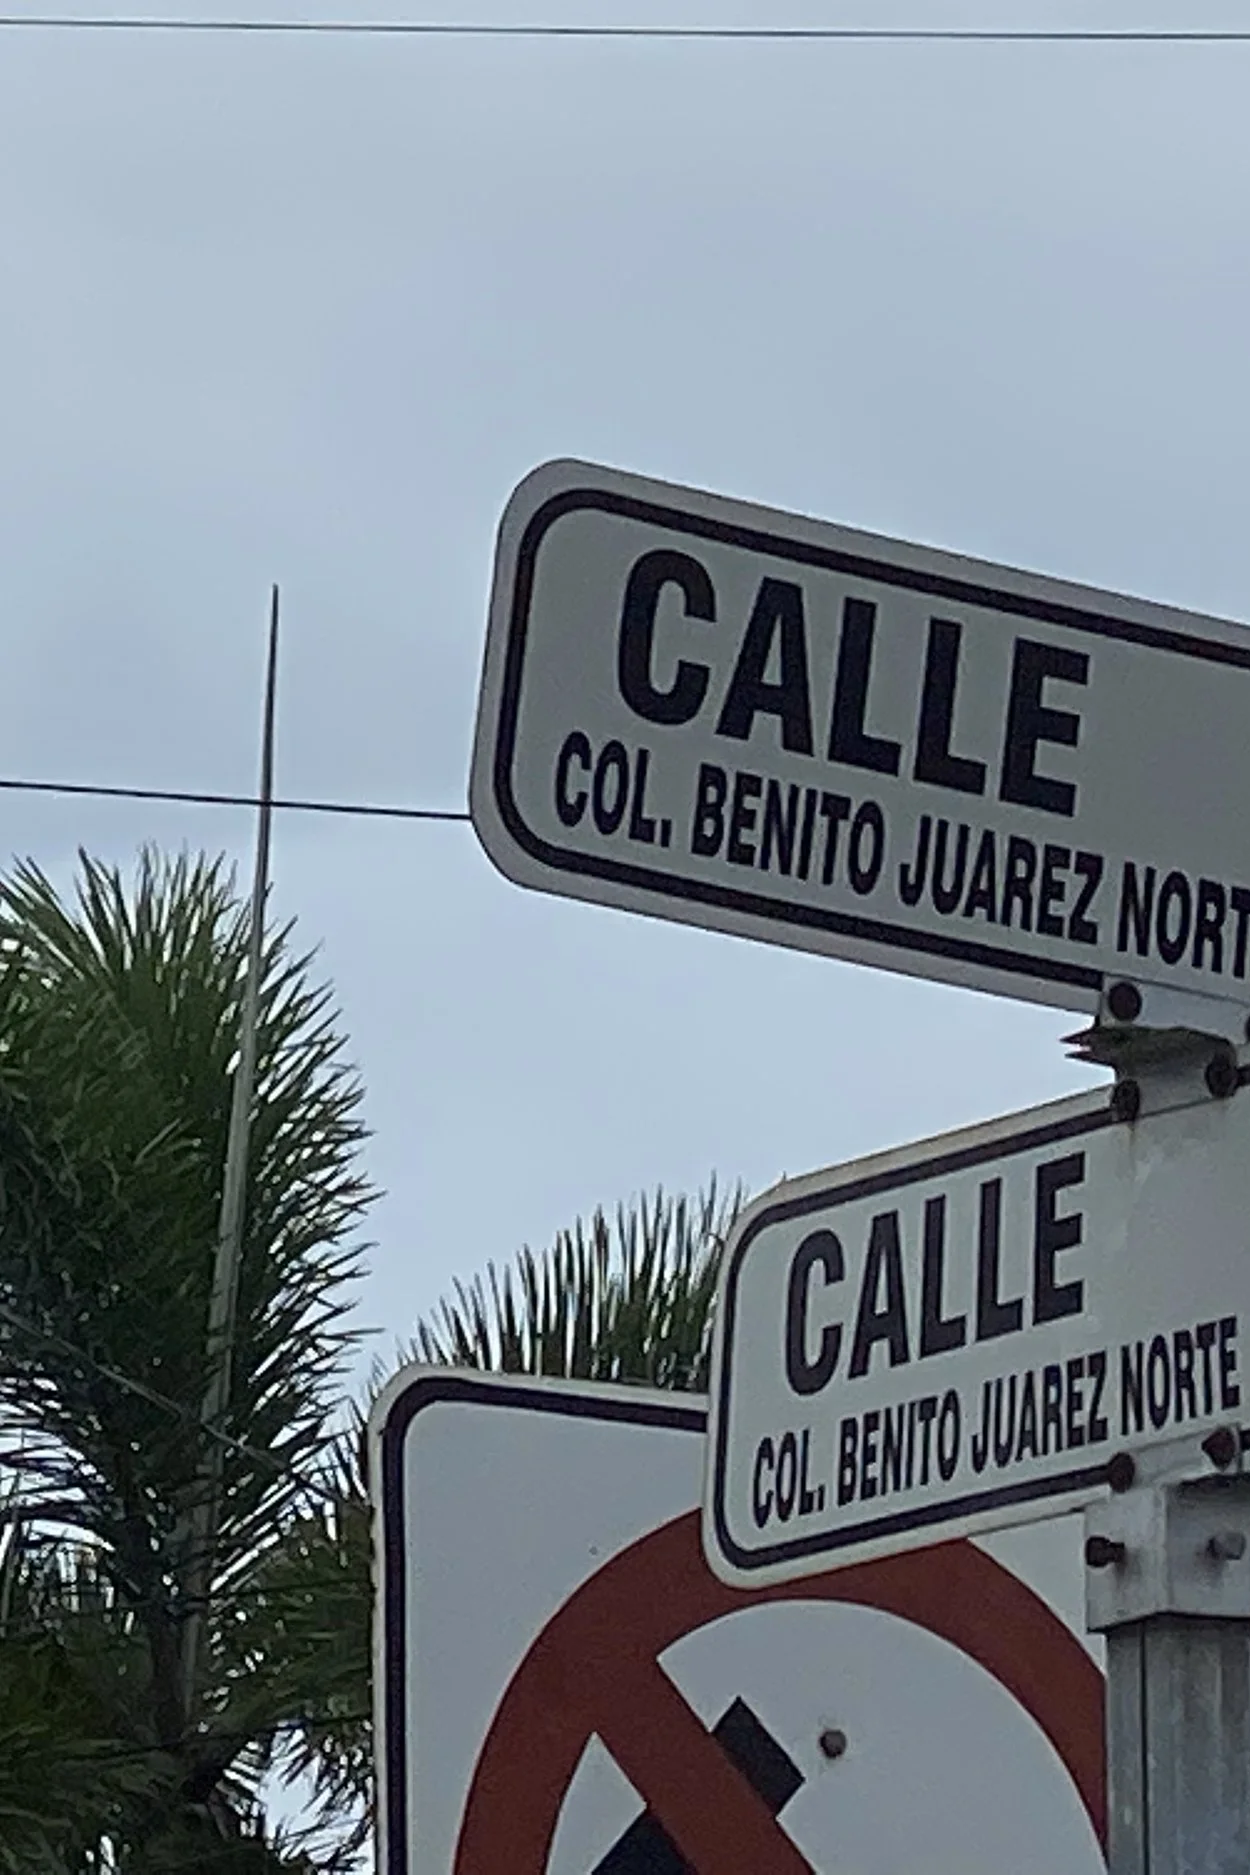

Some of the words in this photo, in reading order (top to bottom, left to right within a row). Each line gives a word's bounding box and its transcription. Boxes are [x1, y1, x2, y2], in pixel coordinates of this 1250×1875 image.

[617, 548, 1091, 819] CALLE
[554, 730, 673, 849] COL.
[690, 761, 886, 896] BENITO
[898, 813, 1105, 946] JUAREZ
[784, 1150, 1086, 1396] CALLE
[752, 1428, 826, 1529] COL.
[837, 1389, 961, 1508] BENITO
[971, 1350, 1109, 1475] JUAREZ
[1120, 1315, 1241, 1437] NORTE
